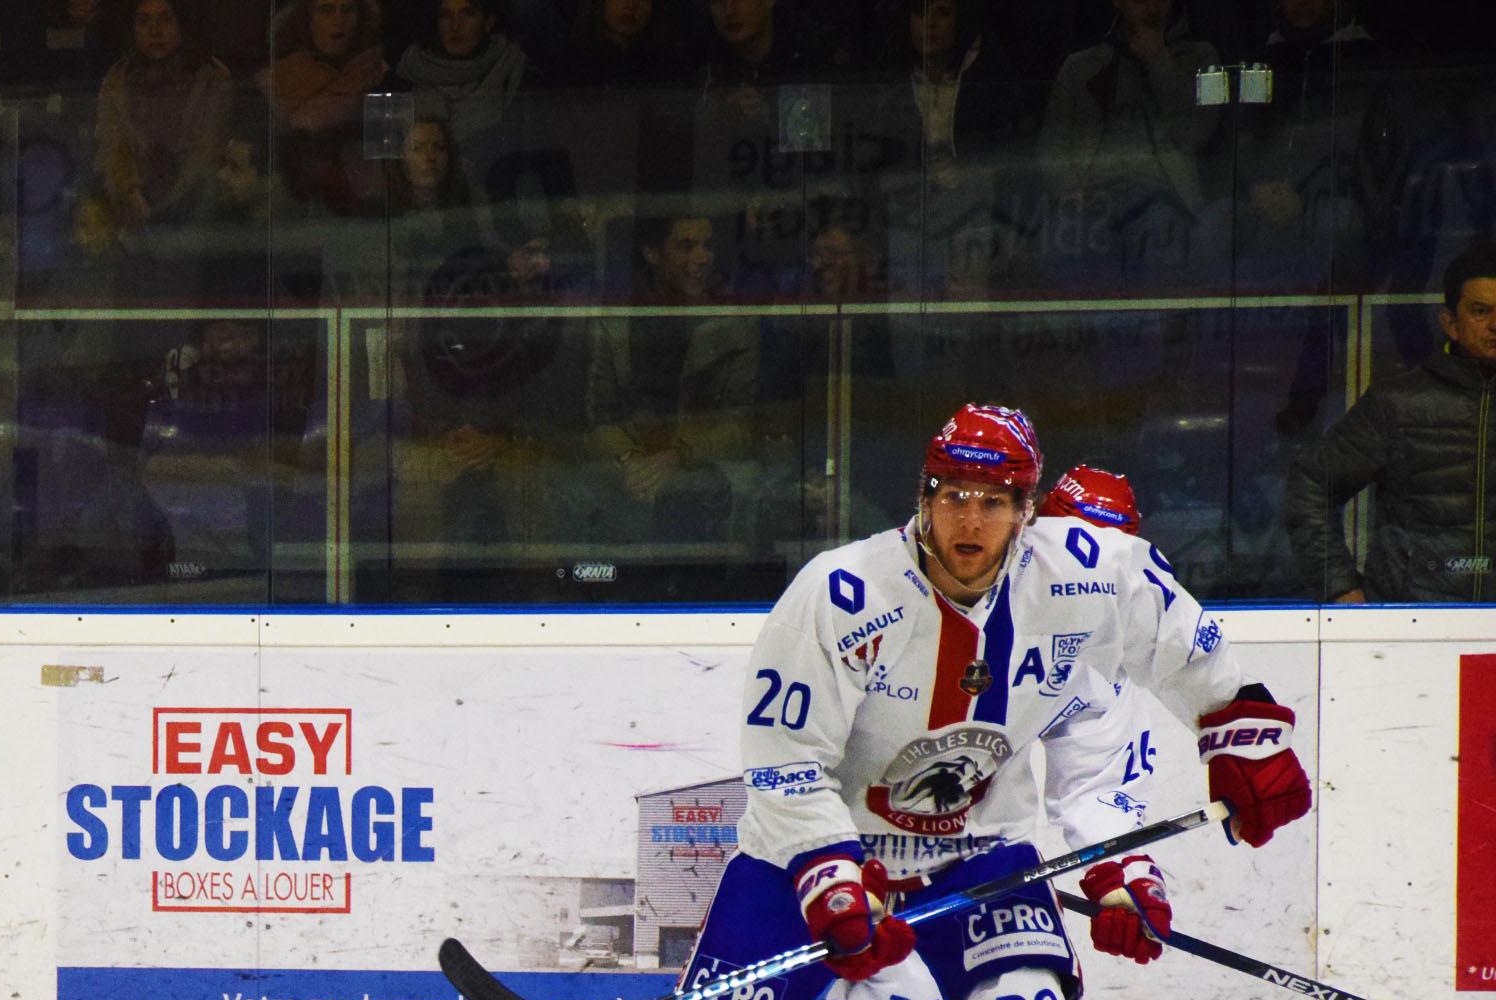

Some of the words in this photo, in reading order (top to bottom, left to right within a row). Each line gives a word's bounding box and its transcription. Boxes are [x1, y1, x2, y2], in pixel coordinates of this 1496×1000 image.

[1050, 582, 1117, 596] RENAUL
[1012, 647, 1045, 687] A
[747, 669, 811, 730] 20
[865, 682, 918, 701] PLOI
[166, 722, 342, 775] EASY
[935, 732, 967, 751] LES
[1198, 727, 1282, 753] AUER
[66, 784, 435, 862] STOCKAGE
[164, 873, 233, 900] BOXES
[243, 873, 258, 899] A
[266, 873, 334, 900] LOUER
[968, 904, 1054, 943] C'PRO
